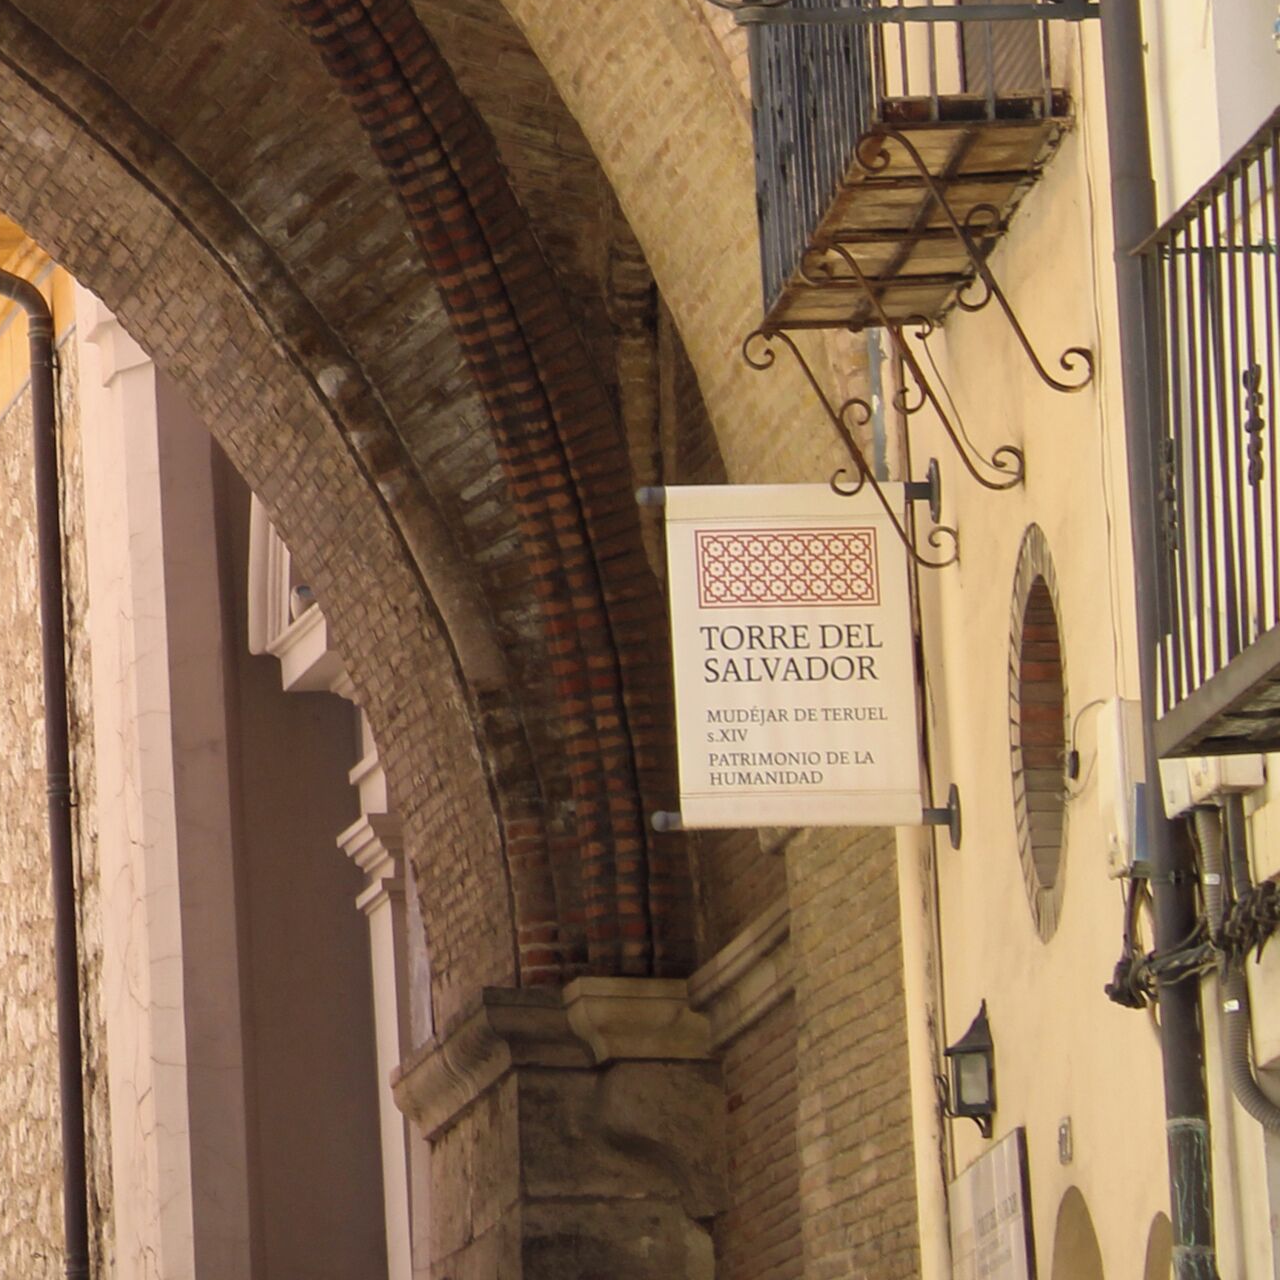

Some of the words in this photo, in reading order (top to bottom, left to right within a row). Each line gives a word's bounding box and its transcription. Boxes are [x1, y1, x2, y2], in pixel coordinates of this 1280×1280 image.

[700, 624, 810, 651] TORRE
[819, 624, 883, 648] DEL
[704, 656, 879, 683] SALVADOR
[707, 705, 789, 725] MUDÉJAR
[794, 708, 818, 722] DE
[821, 706, 888, 721] TERUEL
[709, 751, 821, 767] PATRIMONIO
[826, 751, 850, 765] DE
[854, 751, 874, 765] LA
[710, 770, 823, 786] HUMANIDAD
